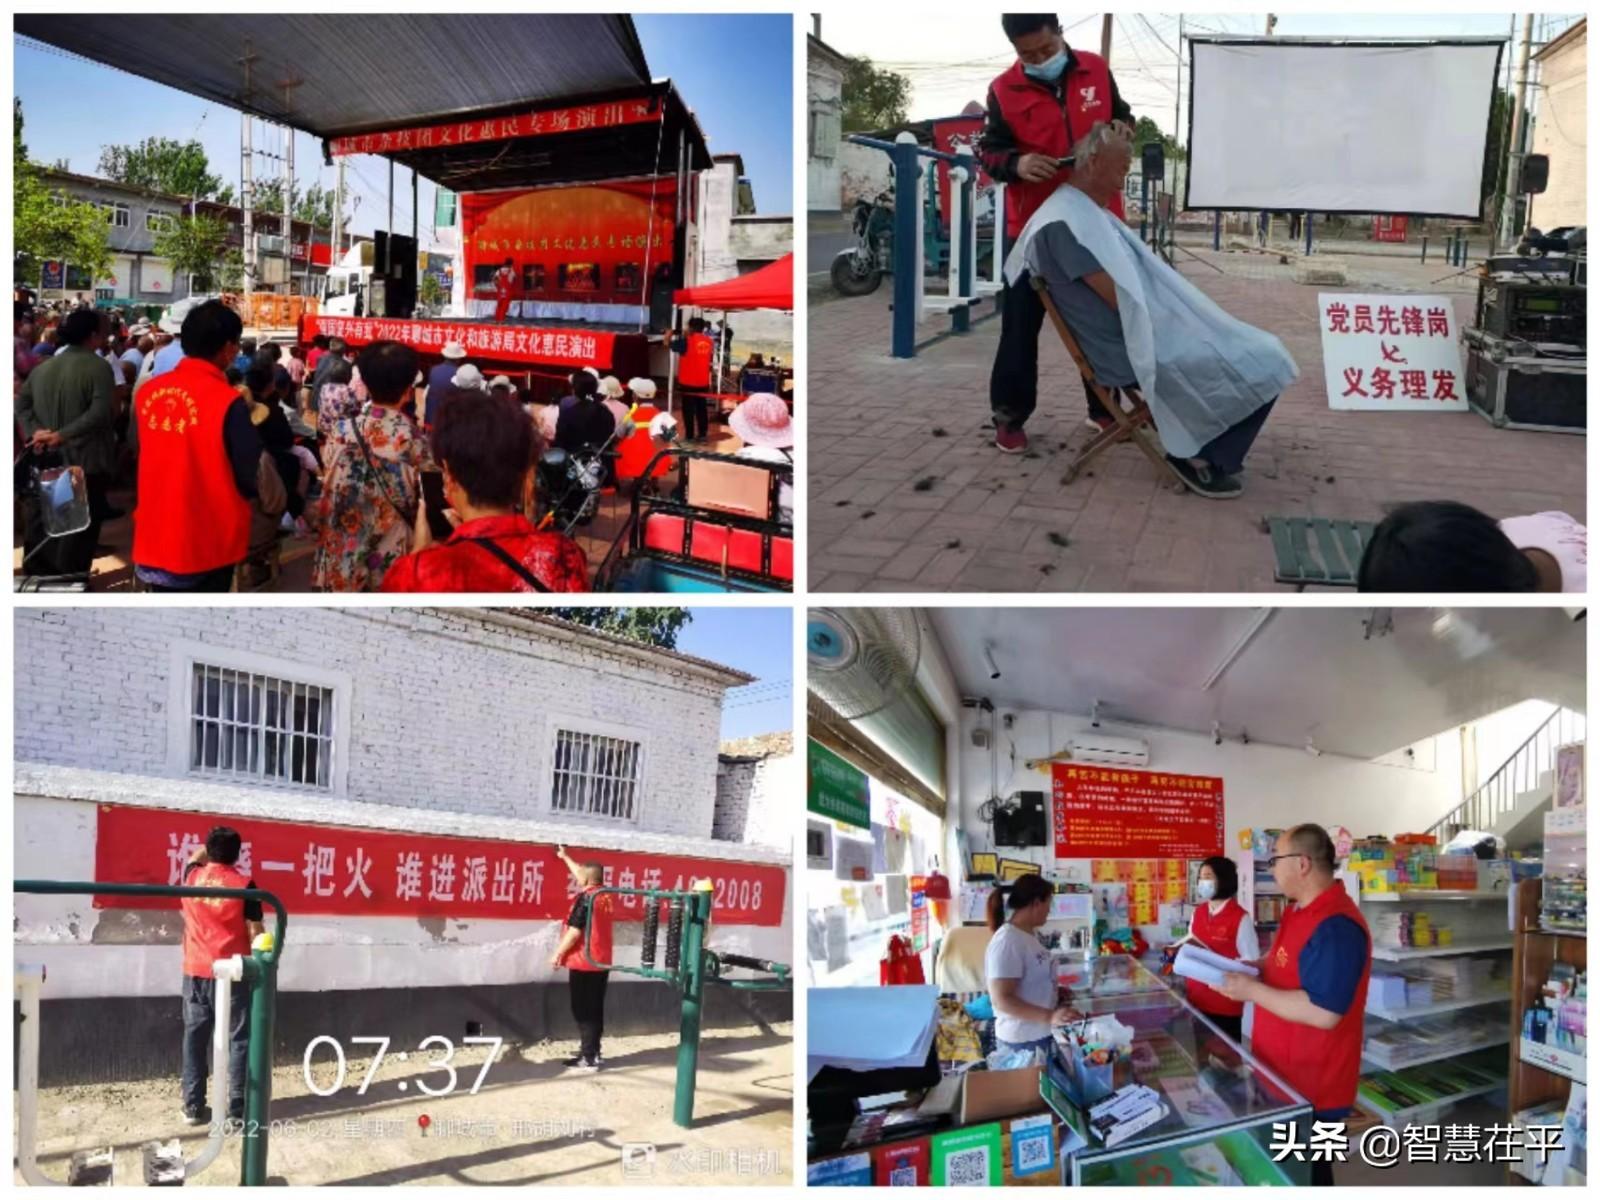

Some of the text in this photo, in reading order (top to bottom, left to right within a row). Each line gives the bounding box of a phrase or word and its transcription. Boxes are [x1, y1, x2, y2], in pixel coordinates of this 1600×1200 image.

[1326, 302, 1449, 337] 党员先锋岗
[1341, 367, 1459, 401] 义务理发
[396, 851, 544, 904] 谁进派出所
